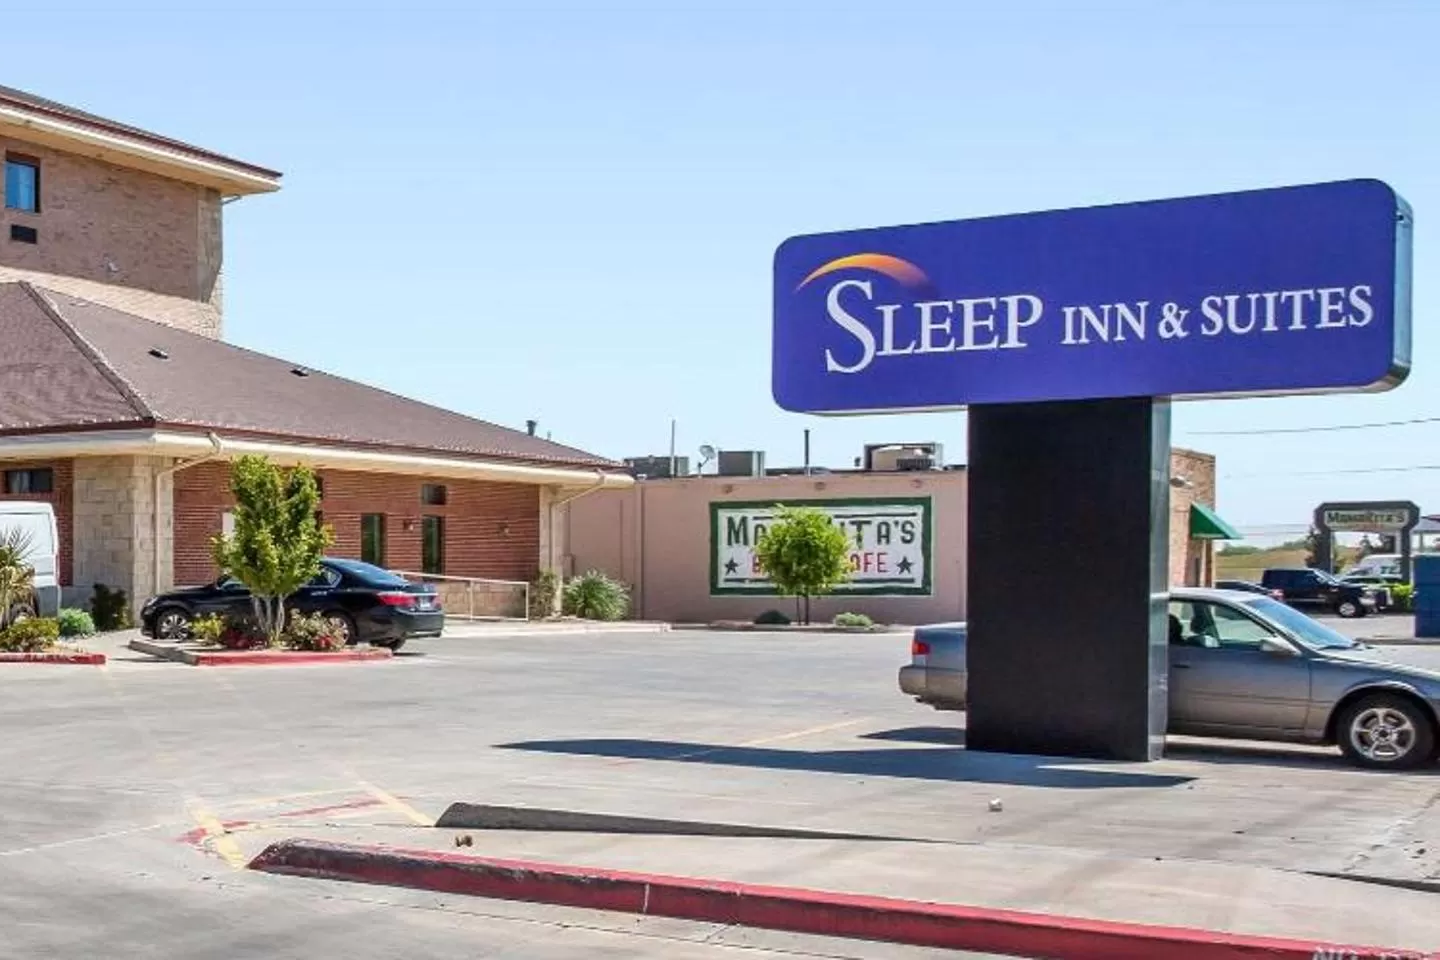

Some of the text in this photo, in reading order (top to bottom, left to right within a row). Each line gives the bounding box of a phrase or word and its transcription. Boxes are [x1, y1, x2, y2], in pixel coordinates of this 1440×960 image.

[825, 280, 1374, 374] SLEEP INN & SUITES
